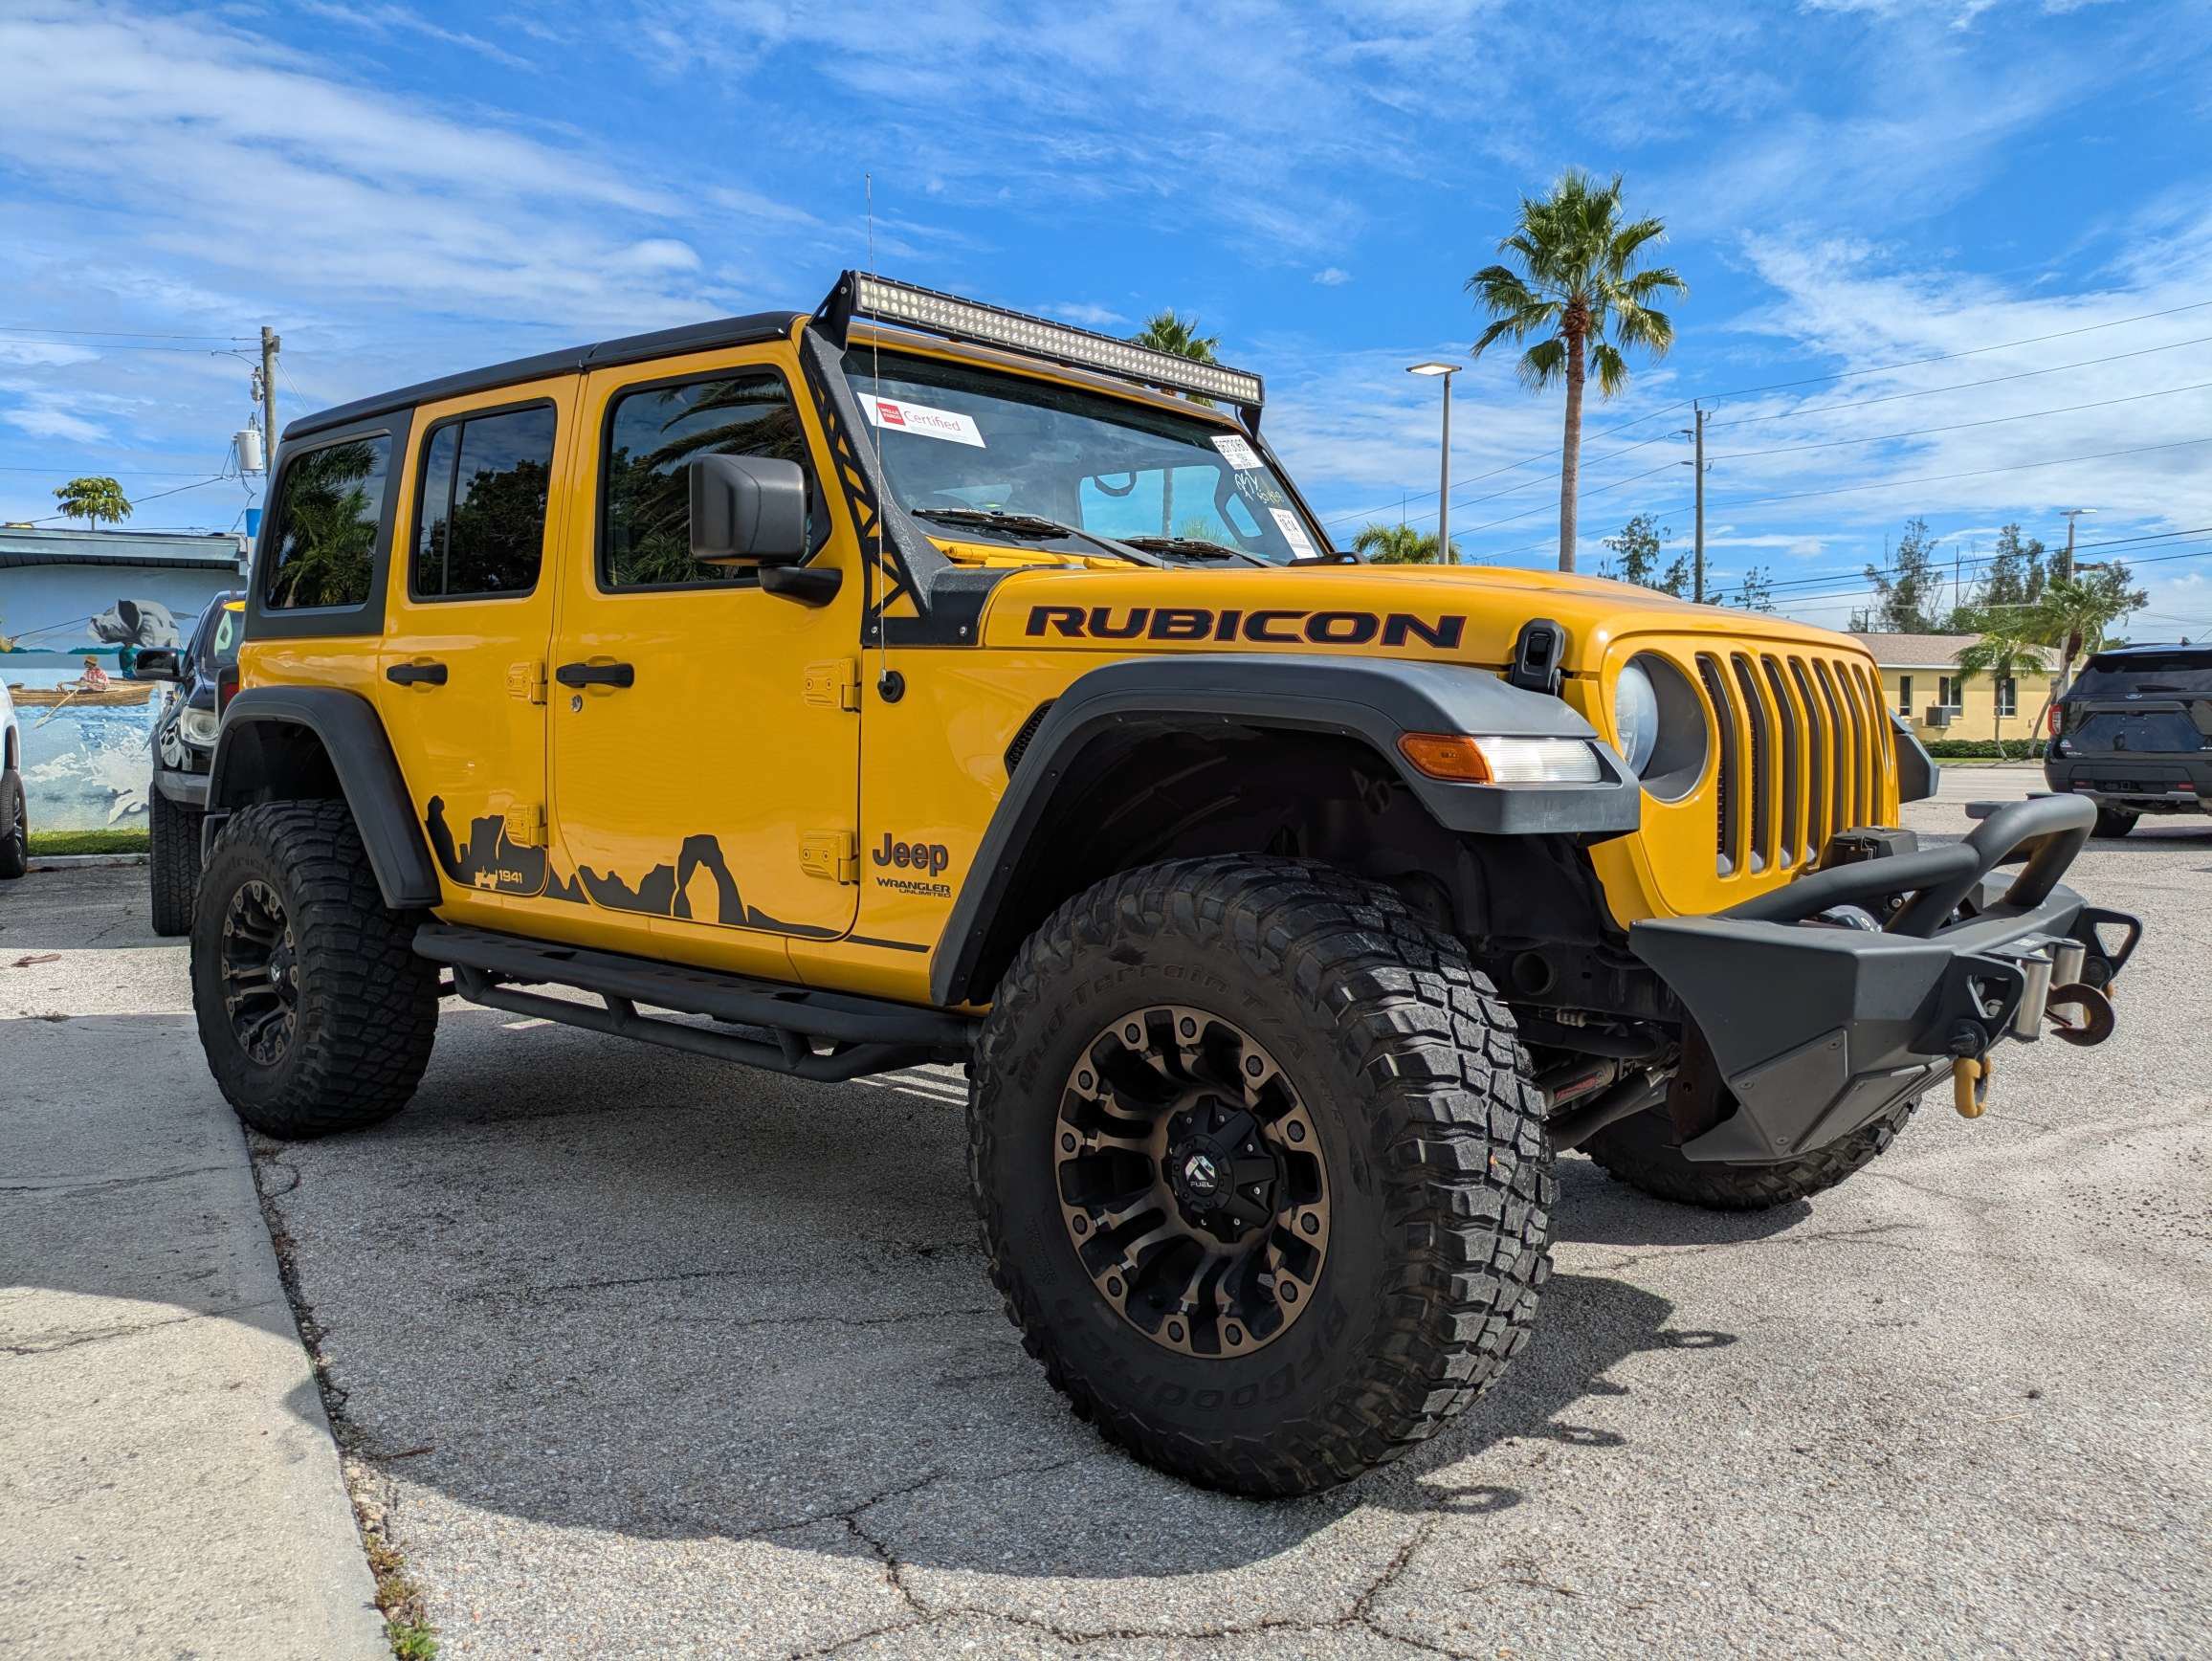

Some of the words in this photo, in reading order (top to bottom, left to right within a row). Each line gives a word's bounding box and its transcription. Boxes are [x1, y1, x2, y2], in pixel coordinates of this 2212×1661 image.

[904, 410, 961, 431] Certified
[1025, 606, 1467, 650] RUBICON
[872, 832, 949, 877] Jeep
[498, 869, 522, 884] 1941
[875, 876, 950, 894] WRANGLER
[898, 888, 951, 898] UNLIMITED
